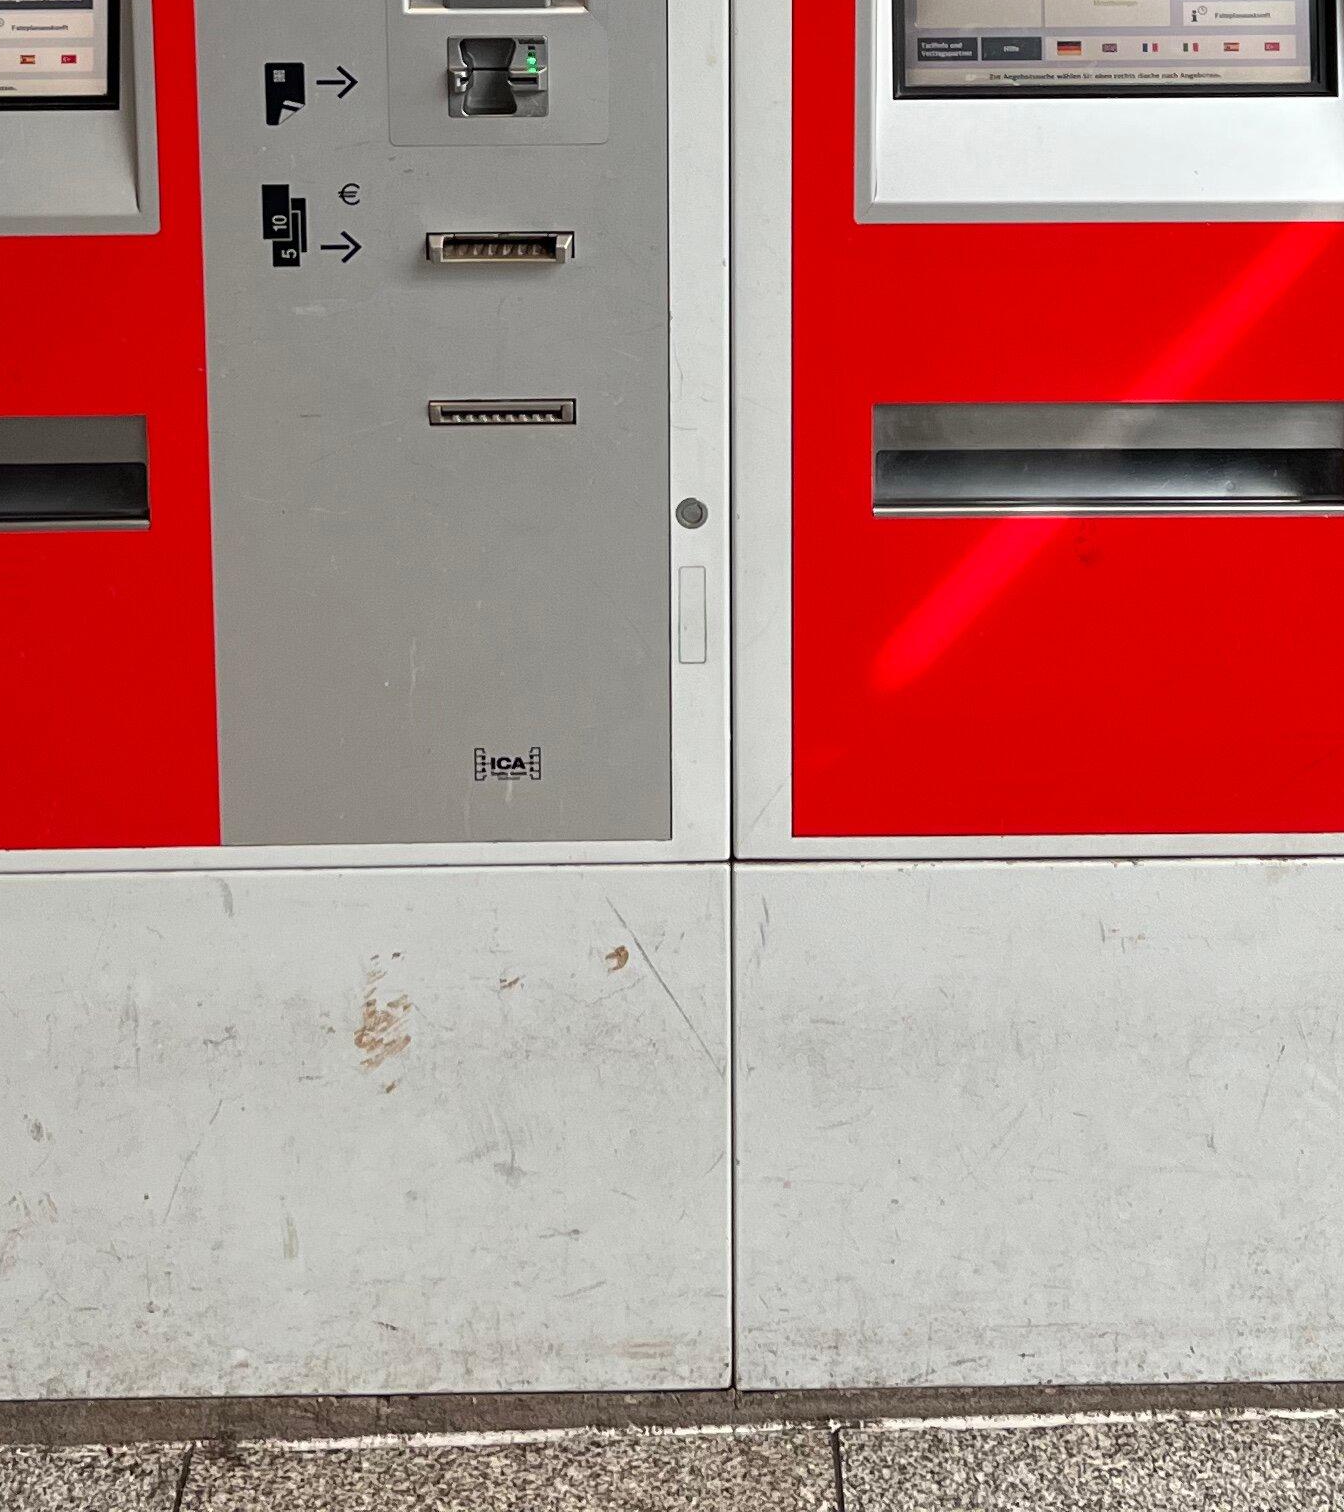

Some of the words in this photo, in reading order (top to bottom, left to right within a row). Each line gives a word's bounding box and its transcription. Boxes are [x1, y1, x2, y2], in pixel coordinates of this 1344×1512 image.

[338, 183, 361, 206] €
[272, 214, 288, 232] 10
[281, 248, 298, 259] 5
[490, 756, 526, 770] ICA
